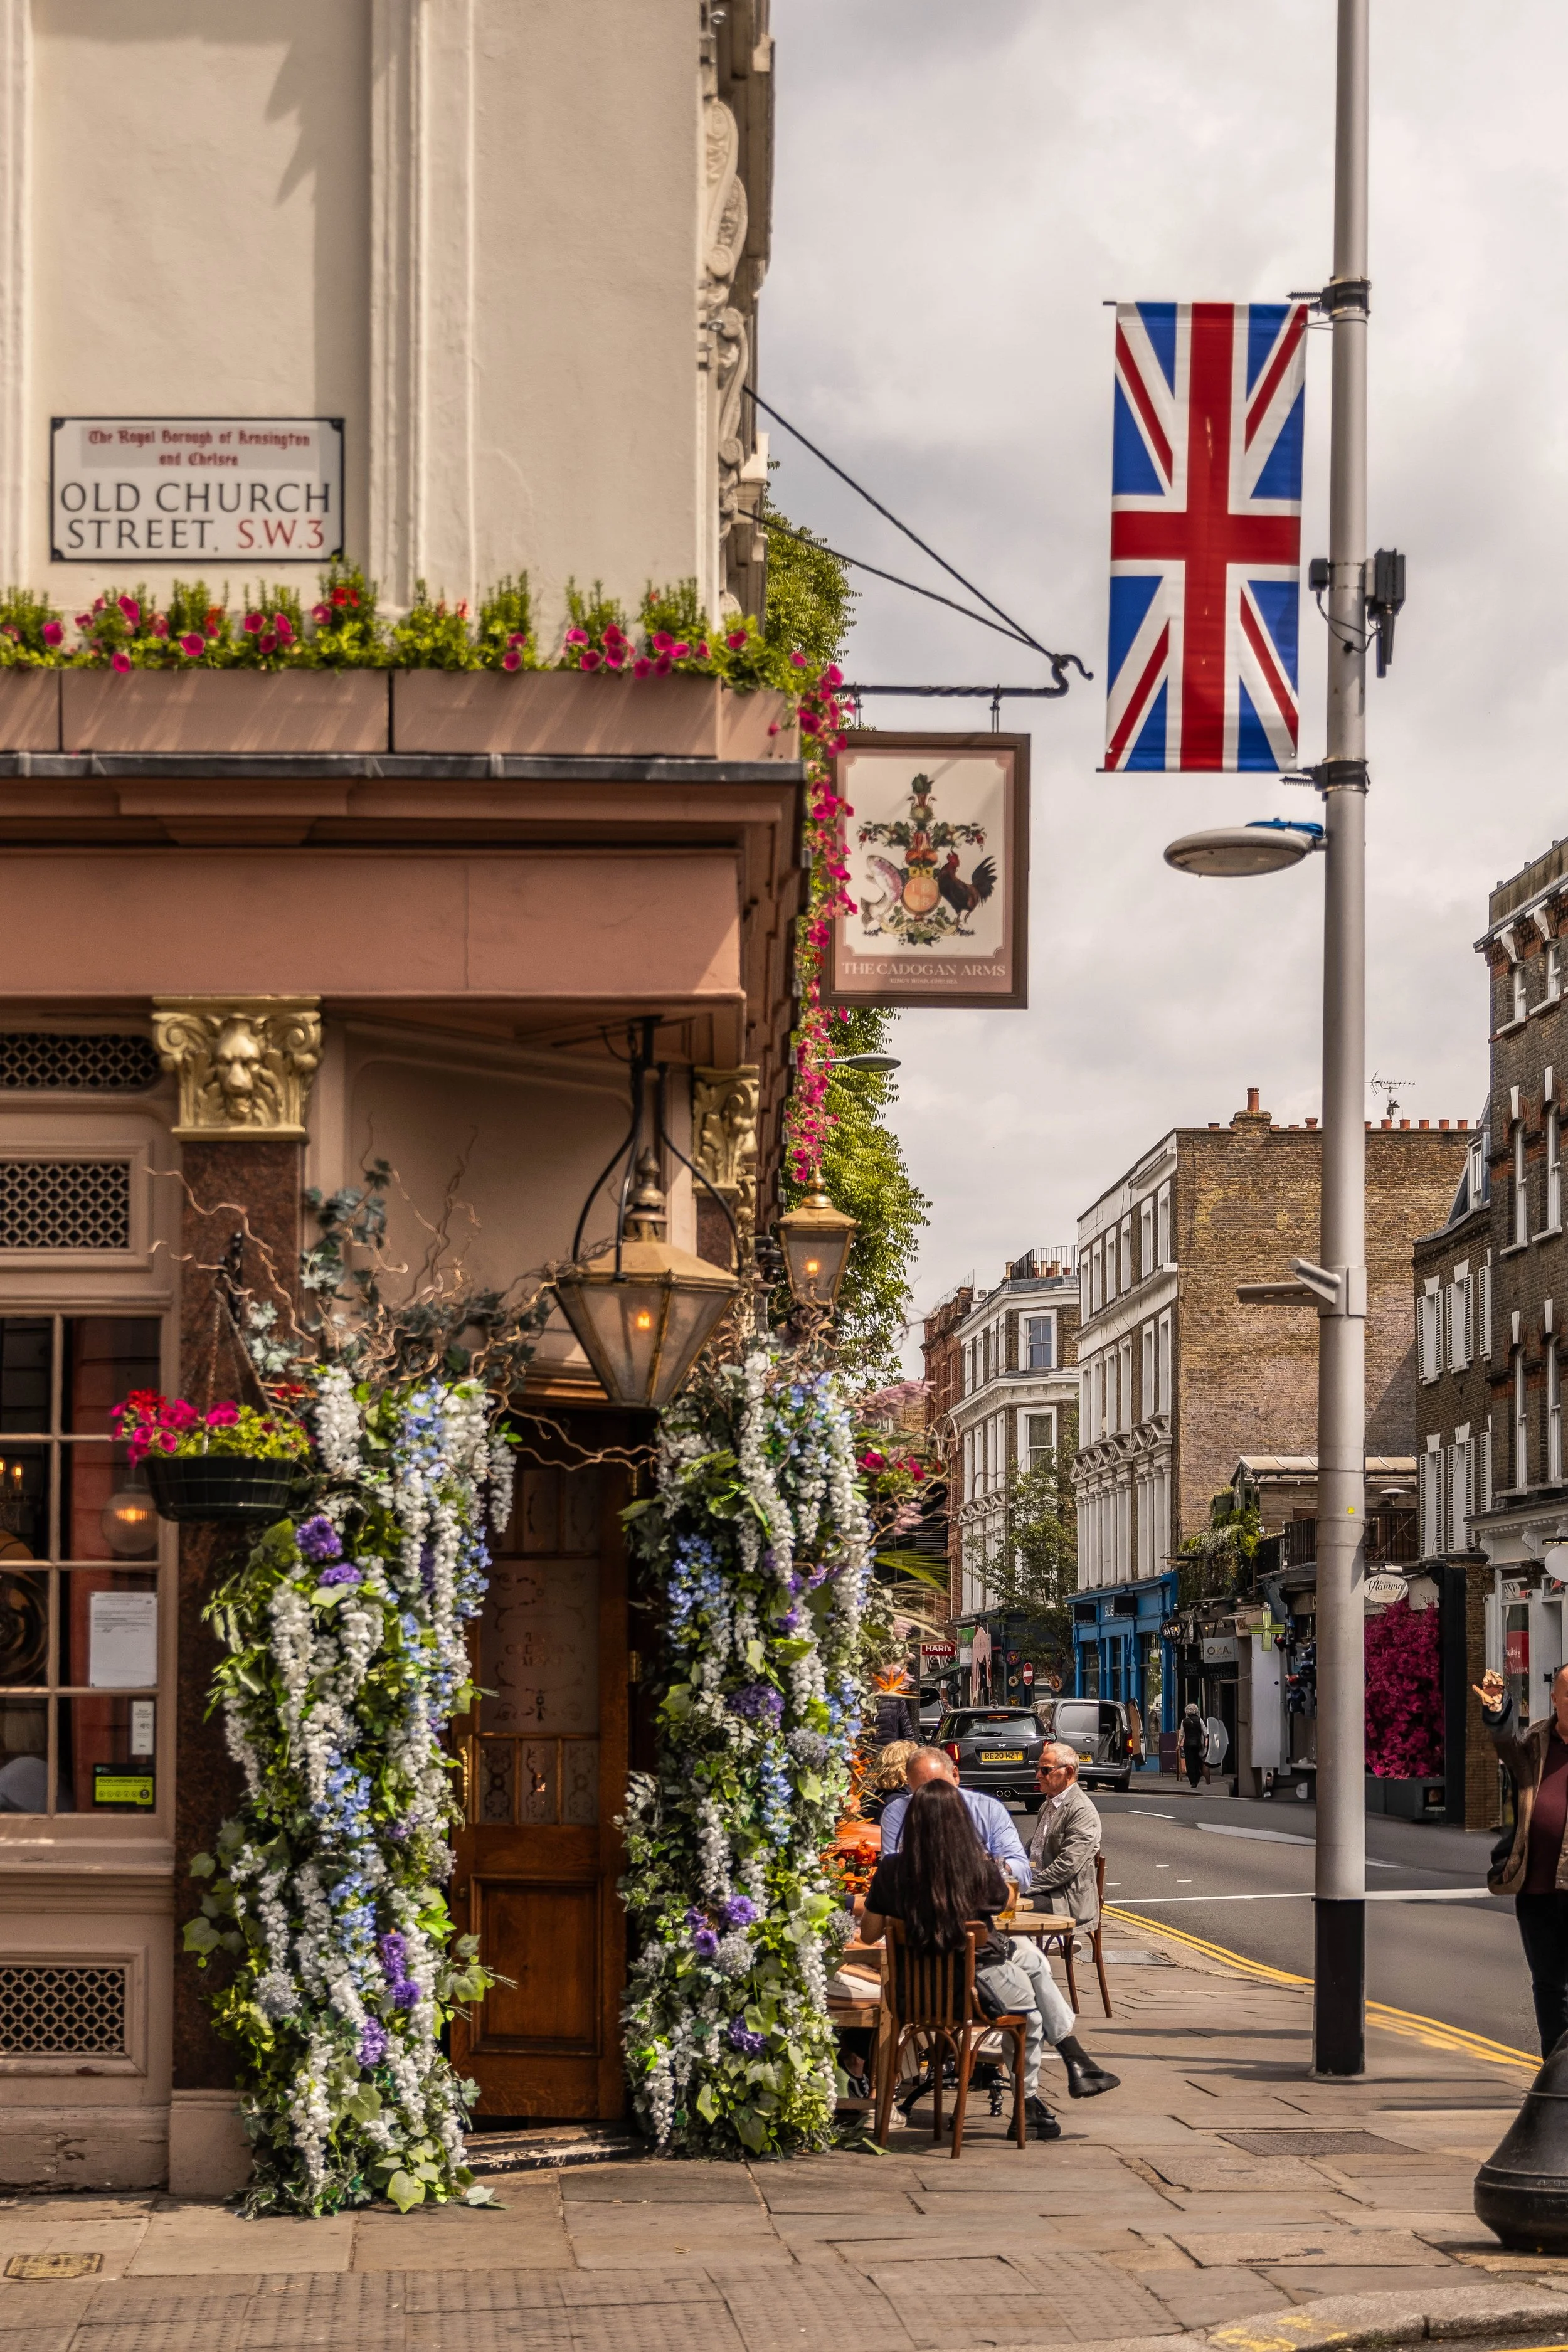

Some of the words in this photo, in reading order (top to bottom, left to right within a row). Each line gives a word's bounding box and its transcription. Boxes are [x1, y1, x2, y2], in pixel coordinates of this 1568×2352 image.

[88, 430, 112, 445] The
[118, 430, 155, 448] Royal
[161, 430, 213, 448] Borough
[219, 430, 232, 444] of
[238, 430, 310, 449] Kensington
[159, 452, 181, 466] and
[188, 452, 239, 467] Chelsea
[61, 482, 141, 512] OLD
[156, 482, 331, 513] CHURCH
[237, 519, 325, 549] S.W.3
[842, 962, 875, 975] THE
[876, 963, 957, 977] CADOGAN
[961, 964, 1006, 977] ARMS
[1368, 1580, 1404, 1591] Mamma
